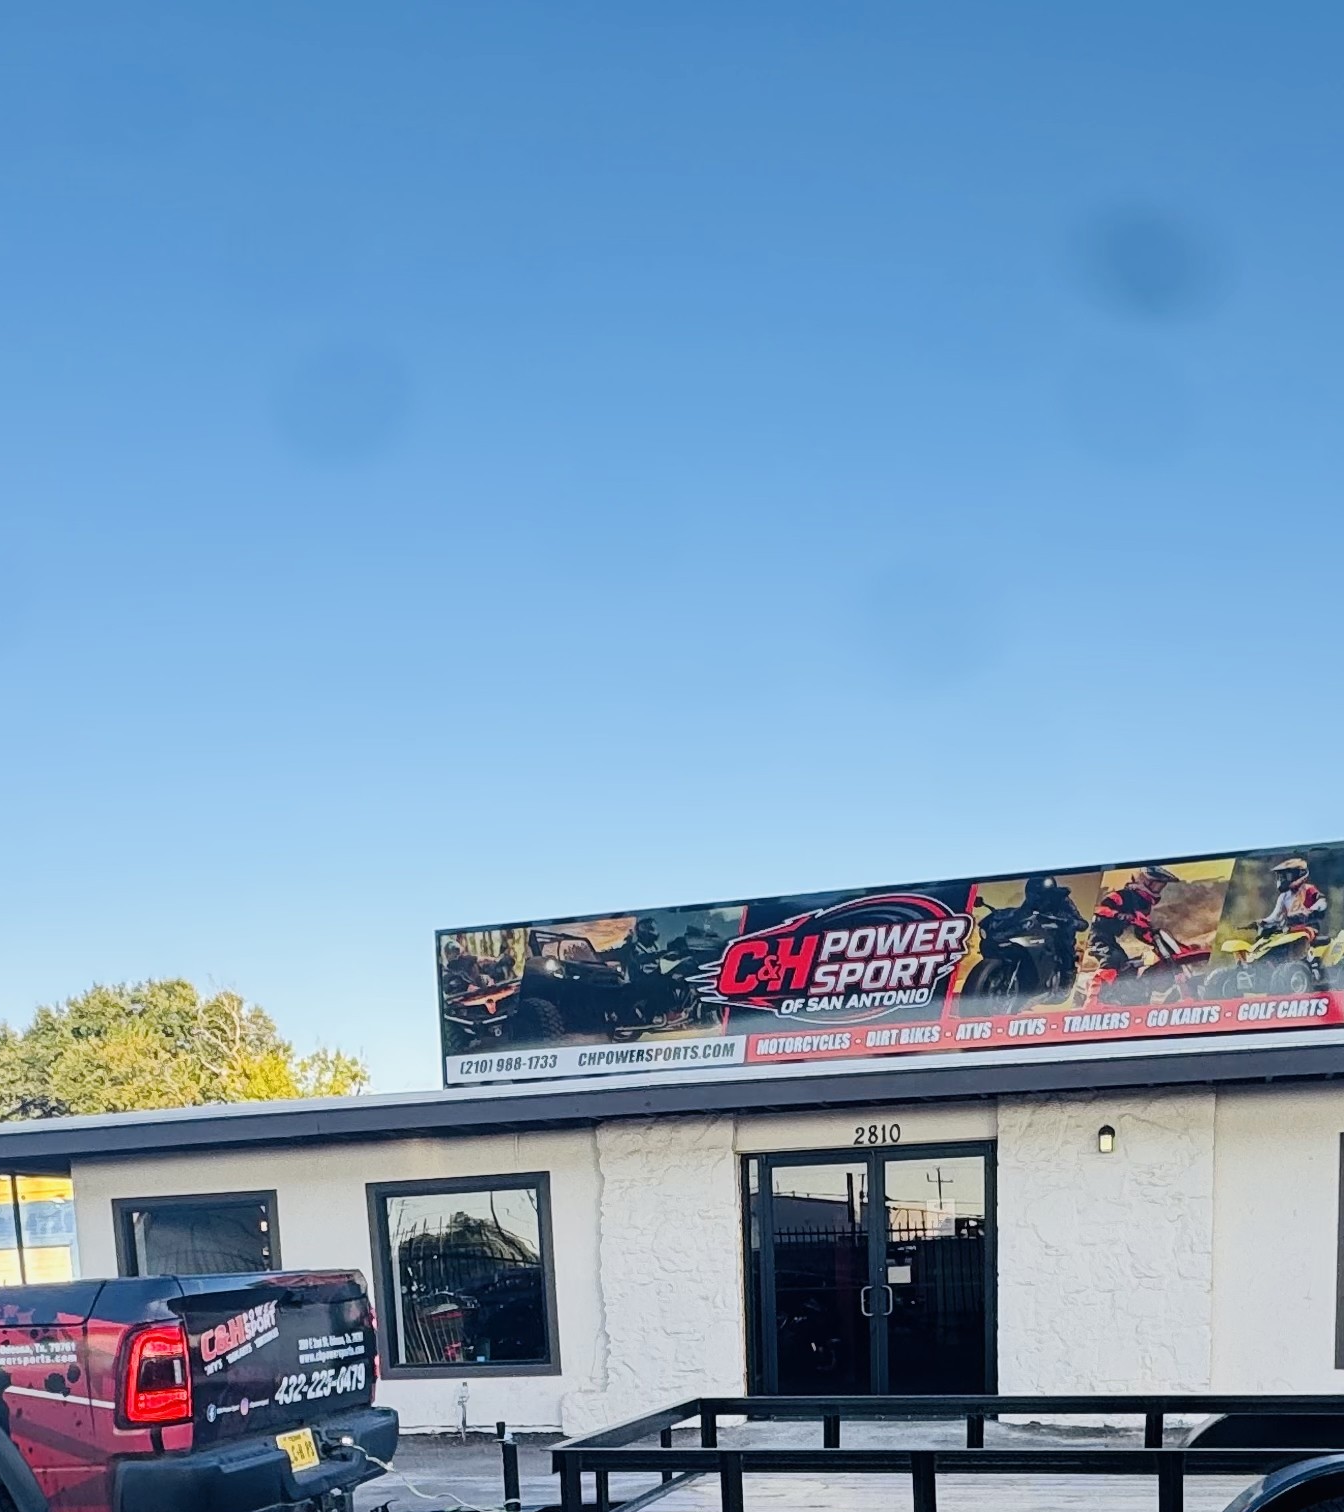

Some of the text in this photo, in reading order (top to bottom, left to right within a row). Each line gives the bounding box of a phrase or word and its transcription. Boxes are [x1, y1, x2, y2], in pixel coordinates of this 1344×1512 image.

[819, 921, 967, 962] POWER
[719, 934, 819, 994] C&H
[809, 955, 946, 994] SPORT
[781, 988, 928, 1014] OF SAN ANTONIO
[757, 998, 1329, 1055] MOTORCYCLES DIRT BIKES ATVS UTVS TRAILERS GO KARTS GOLF CARTS
[460, 1042, 735, 1075] (210) 988-1733 CHPOWERSPORTS.COM
[853, 1123, 901, 1145] 2810
[200, 1314, 247, 1362] C&H
[244, 1309, 276, 1341] SPORT
[274, 1362, 366, 1405] 432-225-0479
